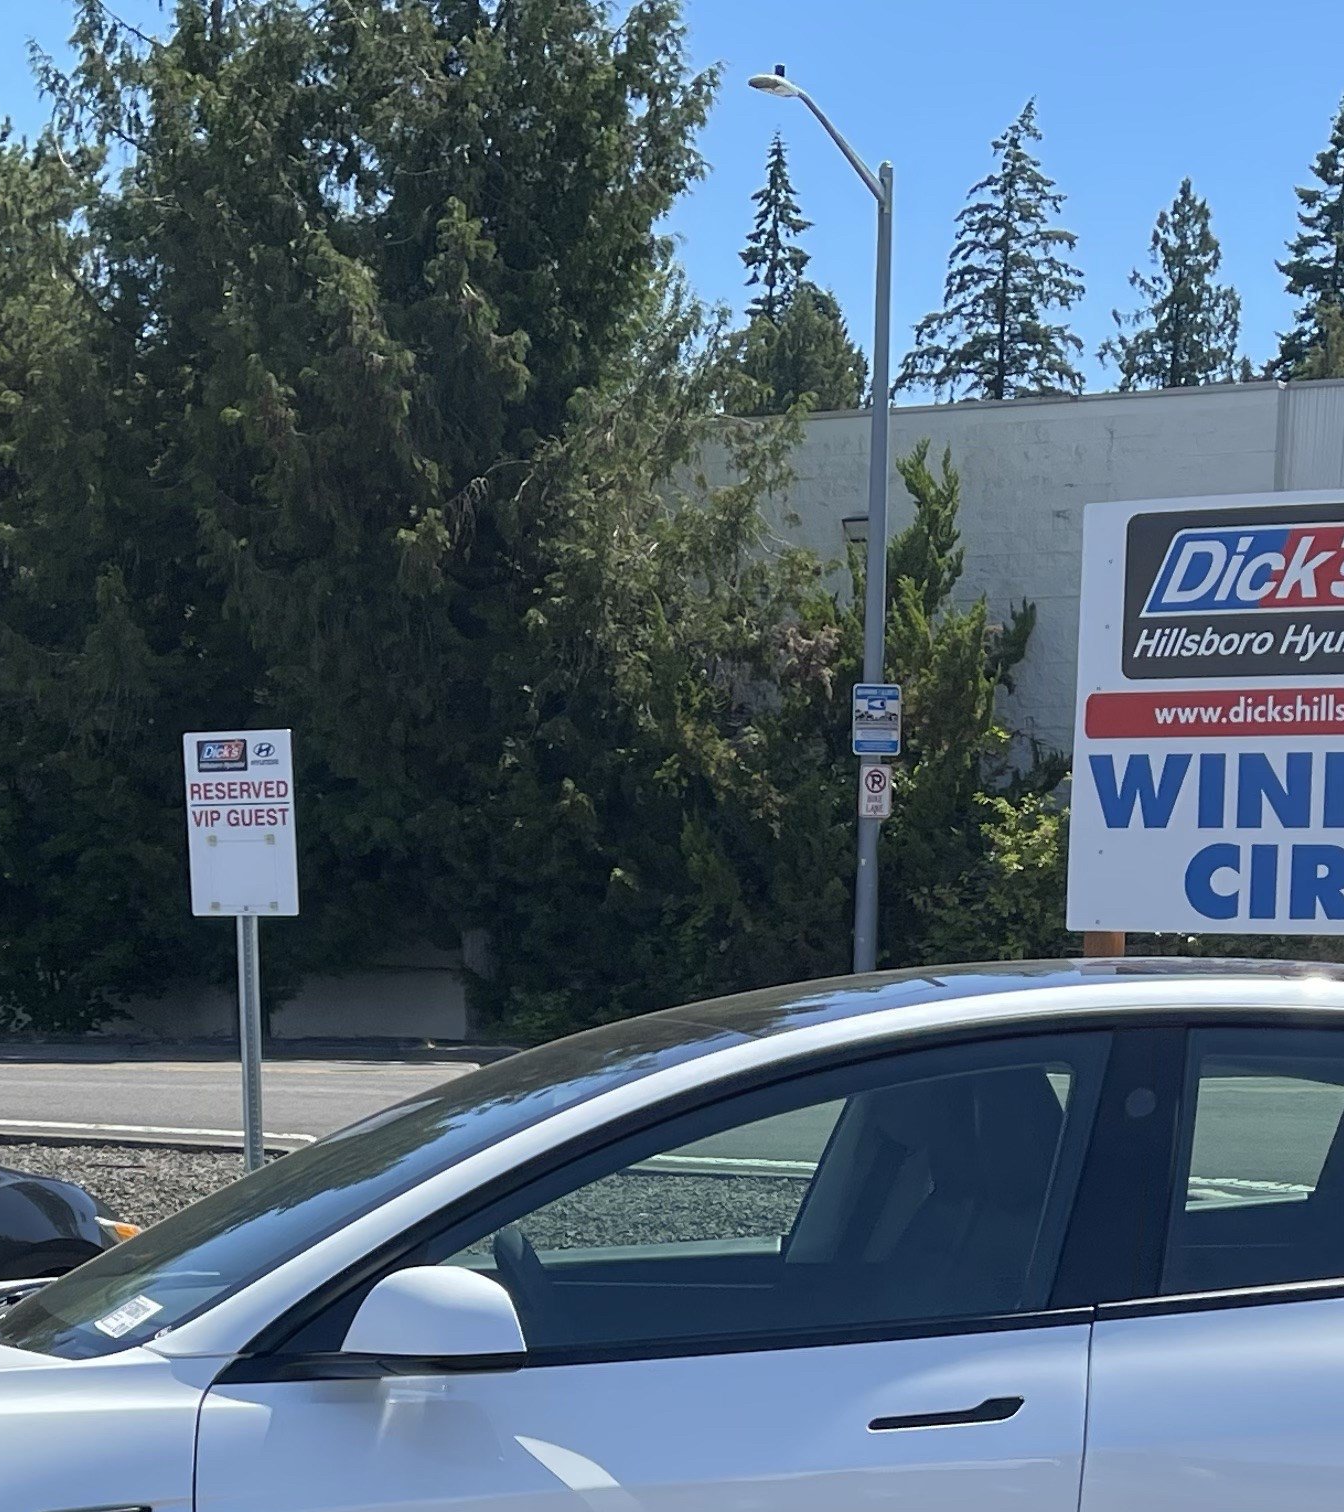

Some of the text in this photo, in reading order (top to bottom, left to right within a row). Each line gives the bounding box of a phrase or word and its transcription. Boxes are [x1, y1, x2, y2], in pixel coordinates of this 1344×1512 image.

[1132, 626, 1274, 659] Hillsboro
[190, 780, 289, 800] RESERVED
[192, 808, 290, 827] VIP GUEST
